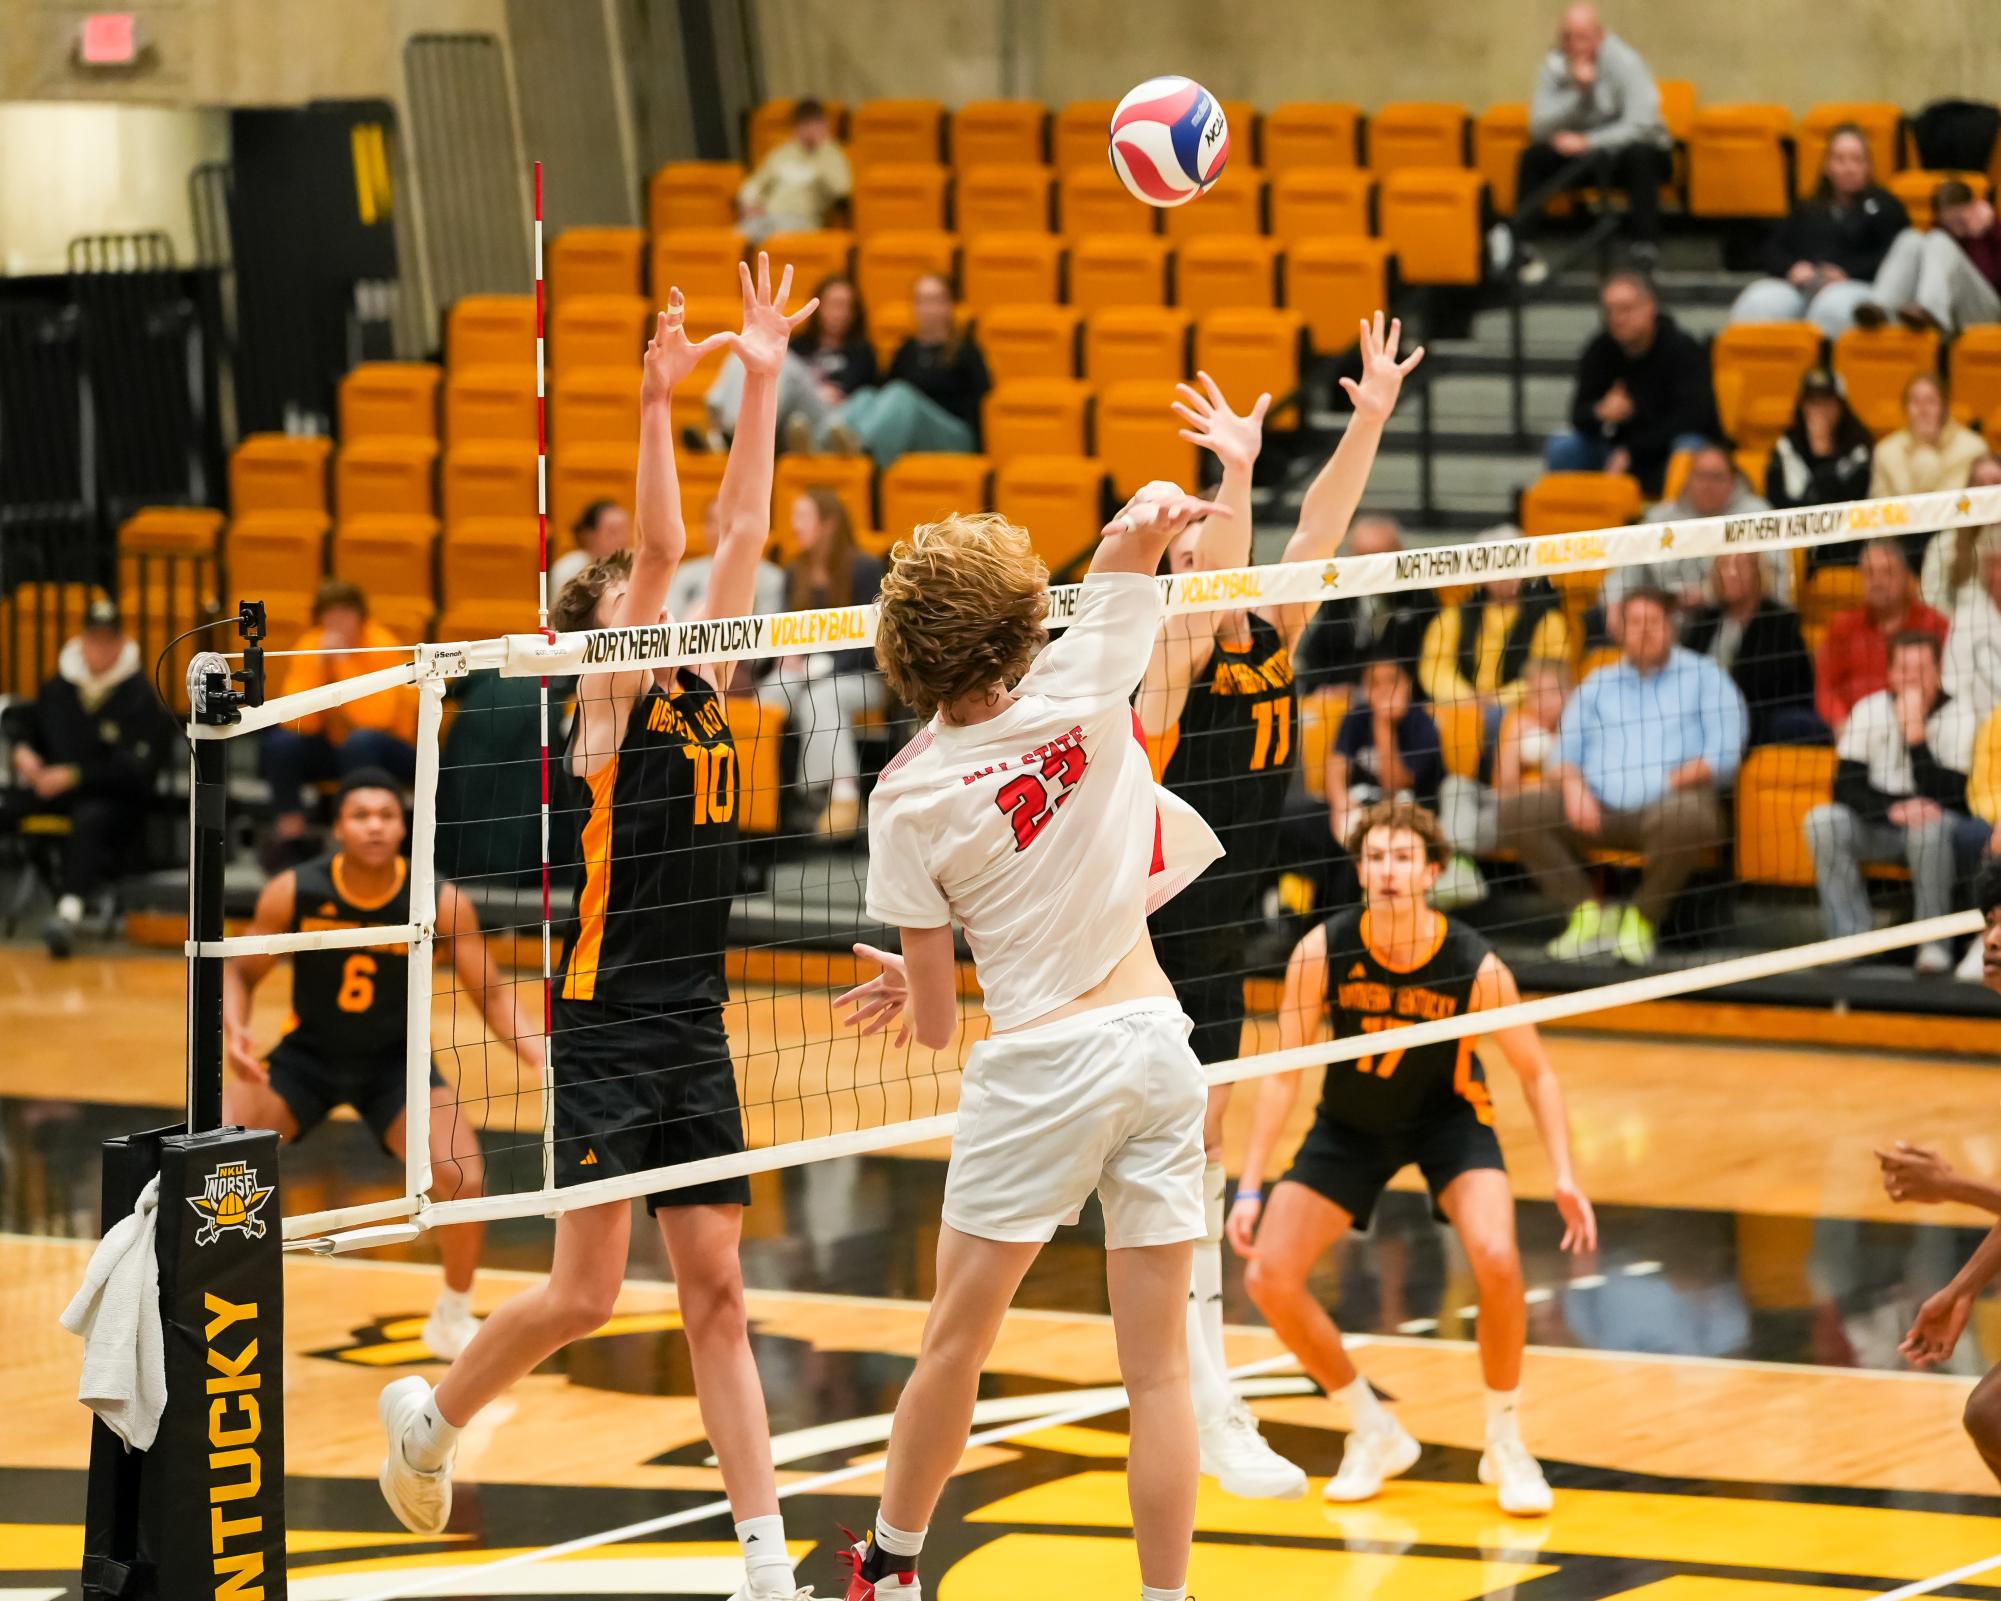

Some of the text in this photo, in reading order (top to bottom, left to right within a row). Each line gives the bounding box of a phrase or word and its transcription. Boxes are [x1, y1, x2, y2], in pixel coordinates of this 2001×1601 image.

[1180, 572, 1263, 602] VOLLEYBALL
[1395, 550, 1462, 580] NORTHERN
[1465, 543, 1531, 573] KENTUCKY
[582, 609, 865, 663] NORTHERN KENTUCKY VOLLEYBALL
[1021, 725, 1088, 764] STATE
[1250, 696, 1291, 770] 11
[682, 742, 735, 825] 10
[995, 744, 1088, 853] 23
[337, 954, 377, 1014] 6
[220, 1165, 243, 1177] NKU
[204, 1291, 265, 1601] NTUCKY
